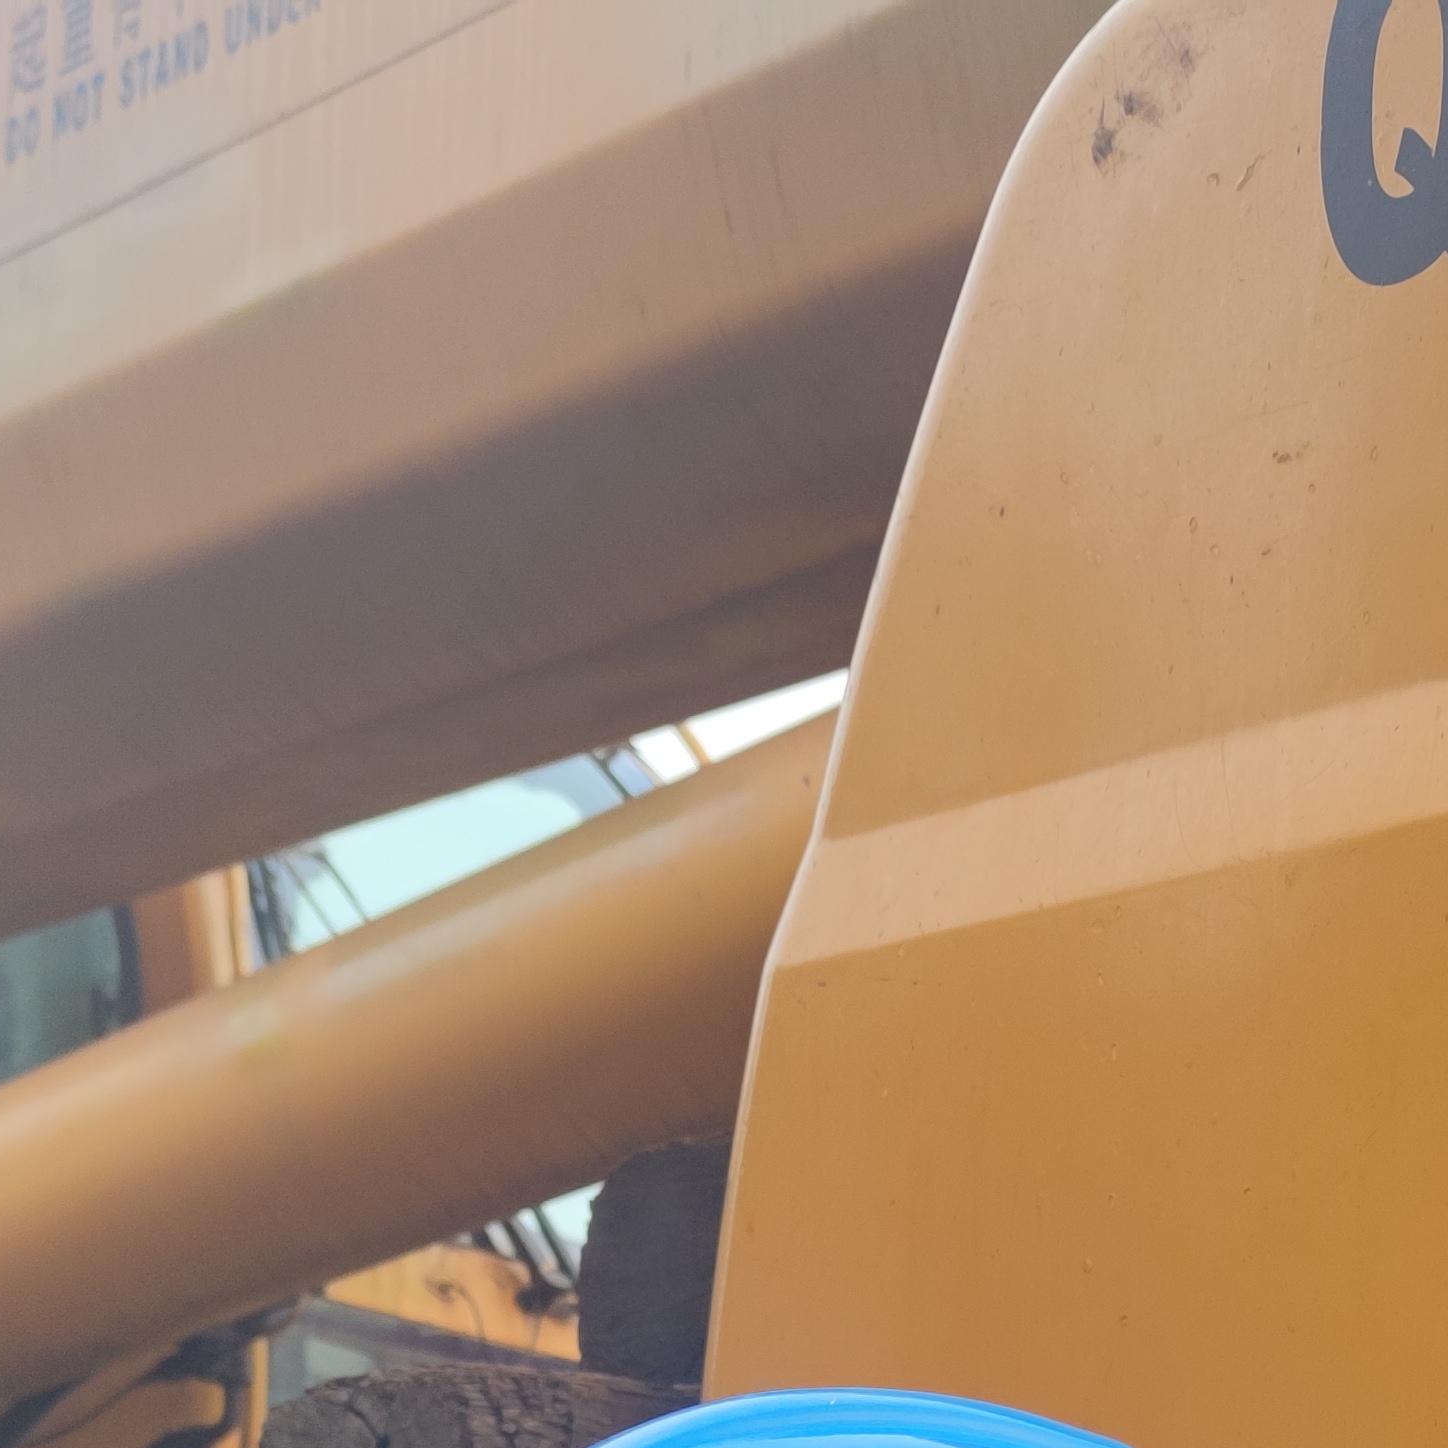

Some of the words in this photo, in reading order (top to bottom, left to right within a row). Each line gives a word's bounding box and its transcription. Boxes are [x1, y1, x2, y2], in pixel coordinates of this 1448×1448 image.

[4, 104, 40, 167] DO
[52, 70, 106, 144] NOT
[118, 20, 210, 110] STAND
